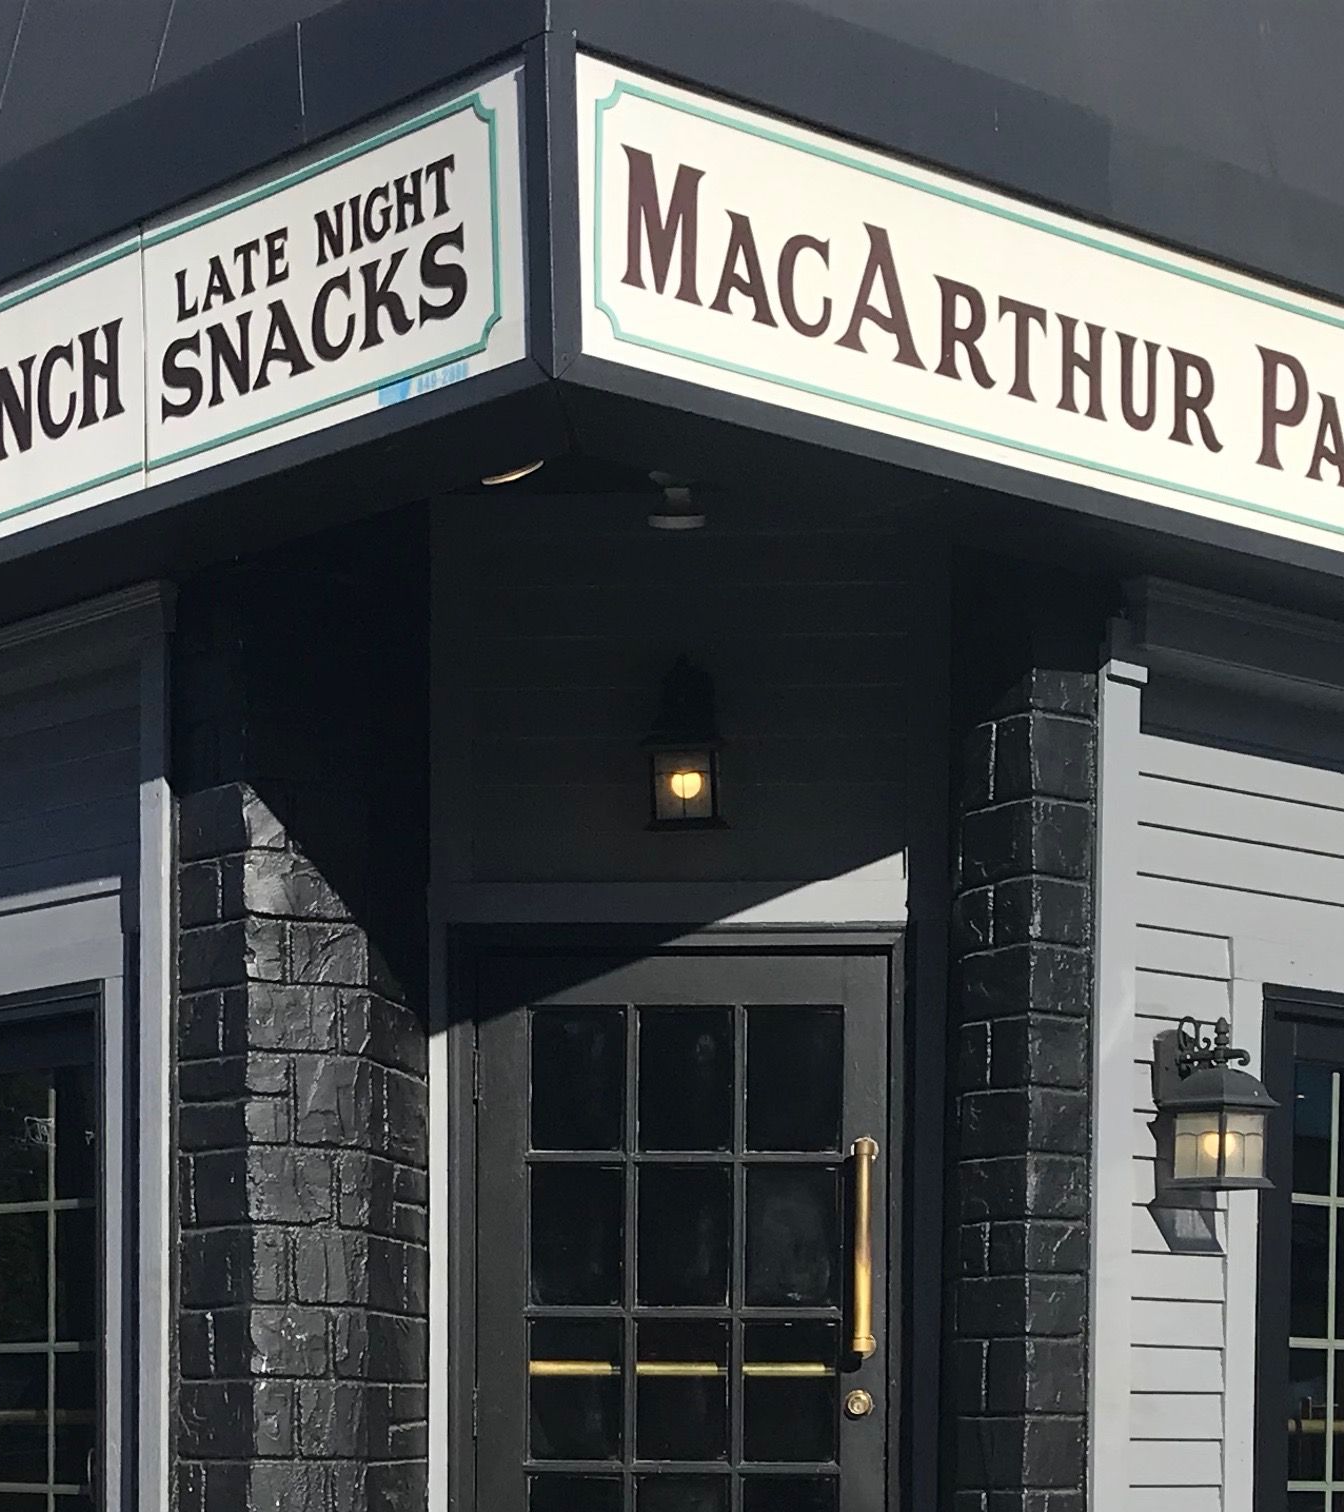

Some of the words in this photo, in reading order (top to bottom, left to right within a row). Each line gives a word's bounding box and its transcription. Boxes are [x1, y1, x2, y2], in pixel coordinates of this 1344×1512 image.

[161, 224, 469, 424] SNACKS
[175, 227, 289, 322] LATE
[314, 154, 455, 267] NIGHT
[620, 144, 1223, 454] MACARTHUR
